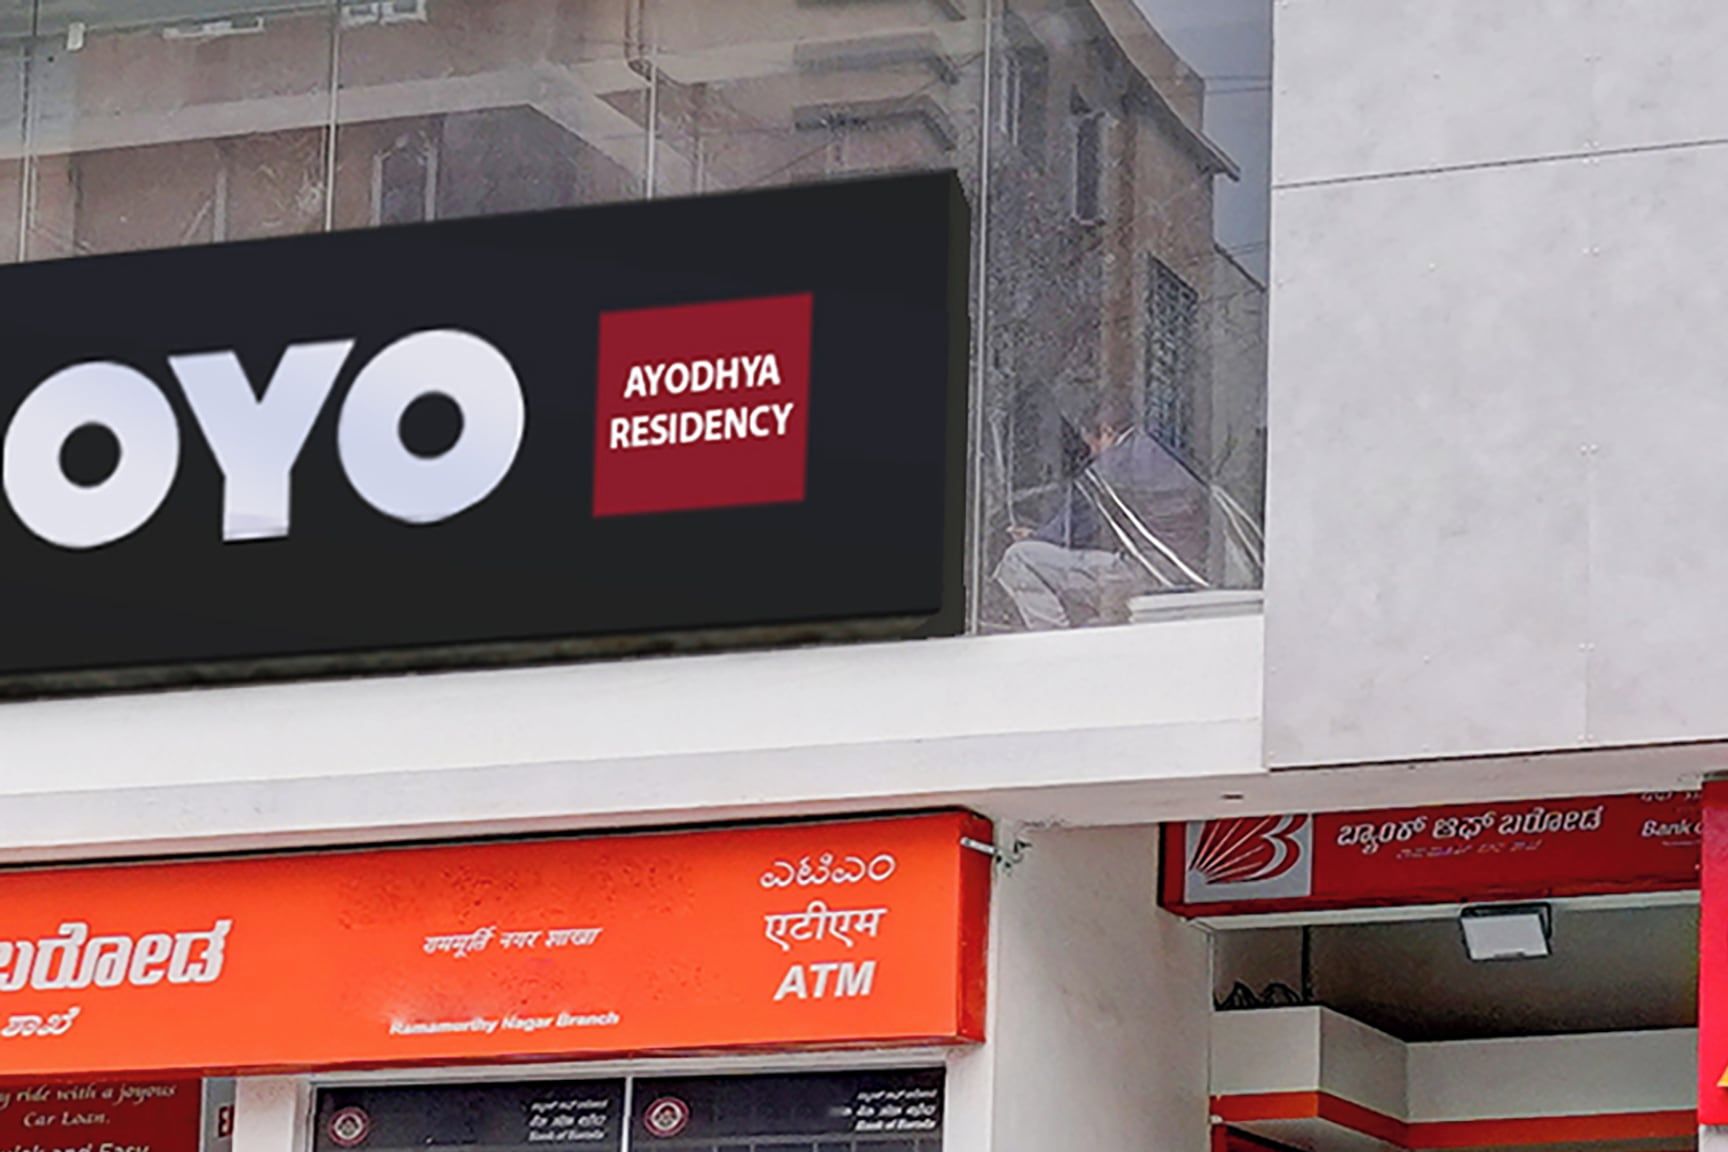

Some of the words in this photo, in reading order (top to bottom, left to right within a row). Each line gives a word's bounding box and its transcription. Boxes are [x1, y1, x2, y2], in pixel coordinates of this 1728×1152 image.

[623, 353, 781, 399] AYODHYA
[2, 329, 526, 549] OYO
[609, 402, 795, 450] RESIDENCY
[1336, 815, 1428, 854] ಬ್ಯಾಂಕ್
[1641, 818, 1692, 837] Bank
[759, 852, 897, 889] ಎಟಿಎಂ
[763, 900, 888, 951] एटीएम
[772, 960, 877, 1001] ATM
